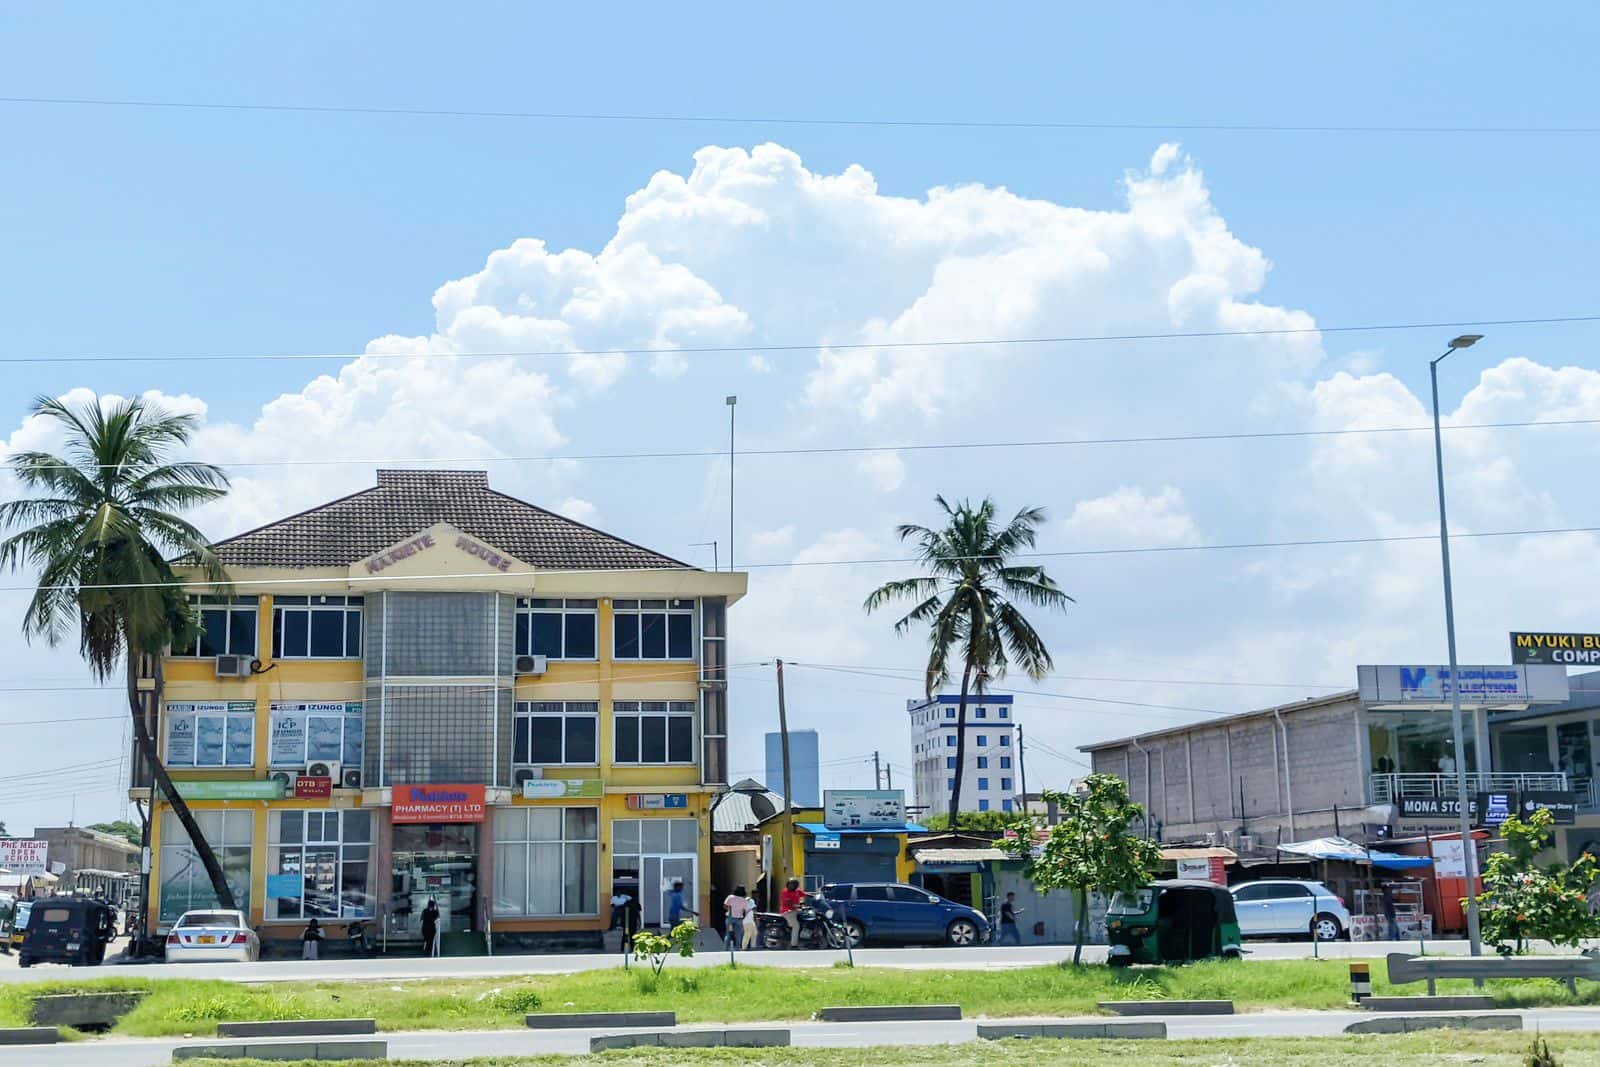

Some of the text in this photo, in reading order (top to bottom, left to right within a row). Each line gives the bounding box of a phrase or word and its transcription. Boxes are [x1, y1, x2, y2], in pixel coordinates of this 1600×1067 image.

[455, 535, 512, 572] HOUSE
[1516, 635, 1576, 648] MYUKI
[1552, 649, 1600, 663] COMP
[1438, 670, 1518, 680] MILIONAIRES
[1442, 683, 1518, 694] CLLECTION
[296, 780, 316, 788] DTB
[395, 804, 448, 813] PHARMACY
[464, 803, 481, 812] LTD
[1404, 800, 1438, 812] MONA
[1441, 801, 1477, 813] STOE
[4, 854, 41, 862] SCHOOL
